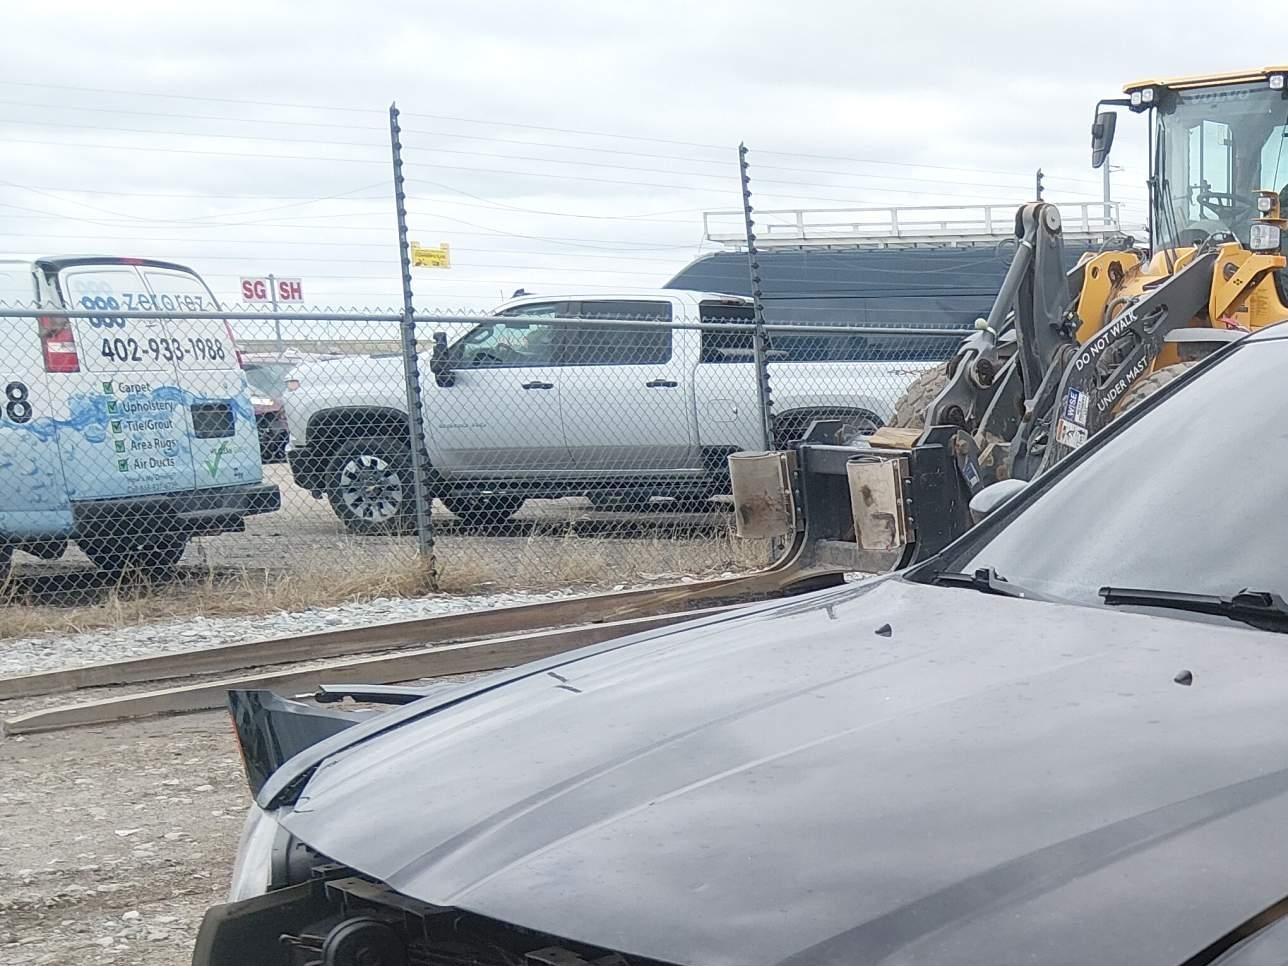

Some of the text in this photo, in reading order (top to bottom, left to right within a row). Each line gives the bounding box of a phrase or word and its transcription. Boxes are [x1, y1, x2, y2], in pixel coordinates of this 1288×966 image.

[243, 281, 267, 299] SG
[280, 282, 302, 300] SH
[122, 293, 207, 311] zerorez
[1075, 309, 1138, 372] DO NOT WALK
[101, 338, 225, 362] 402-933-1988
[118, 382, 151, 394] Carpet
[1097, 355, 1149, 411] UNDER MAST
[0, 381, 33, 424] 8
[122, 400, 174, 413] Upholstery
[1067, 391, 1079, 417] WISE
[127, 420, 173, 432] Tile/Grout
[130, 438, 177, 450] Area Rugs
[134, 457, 175, 469] Air Ducts
